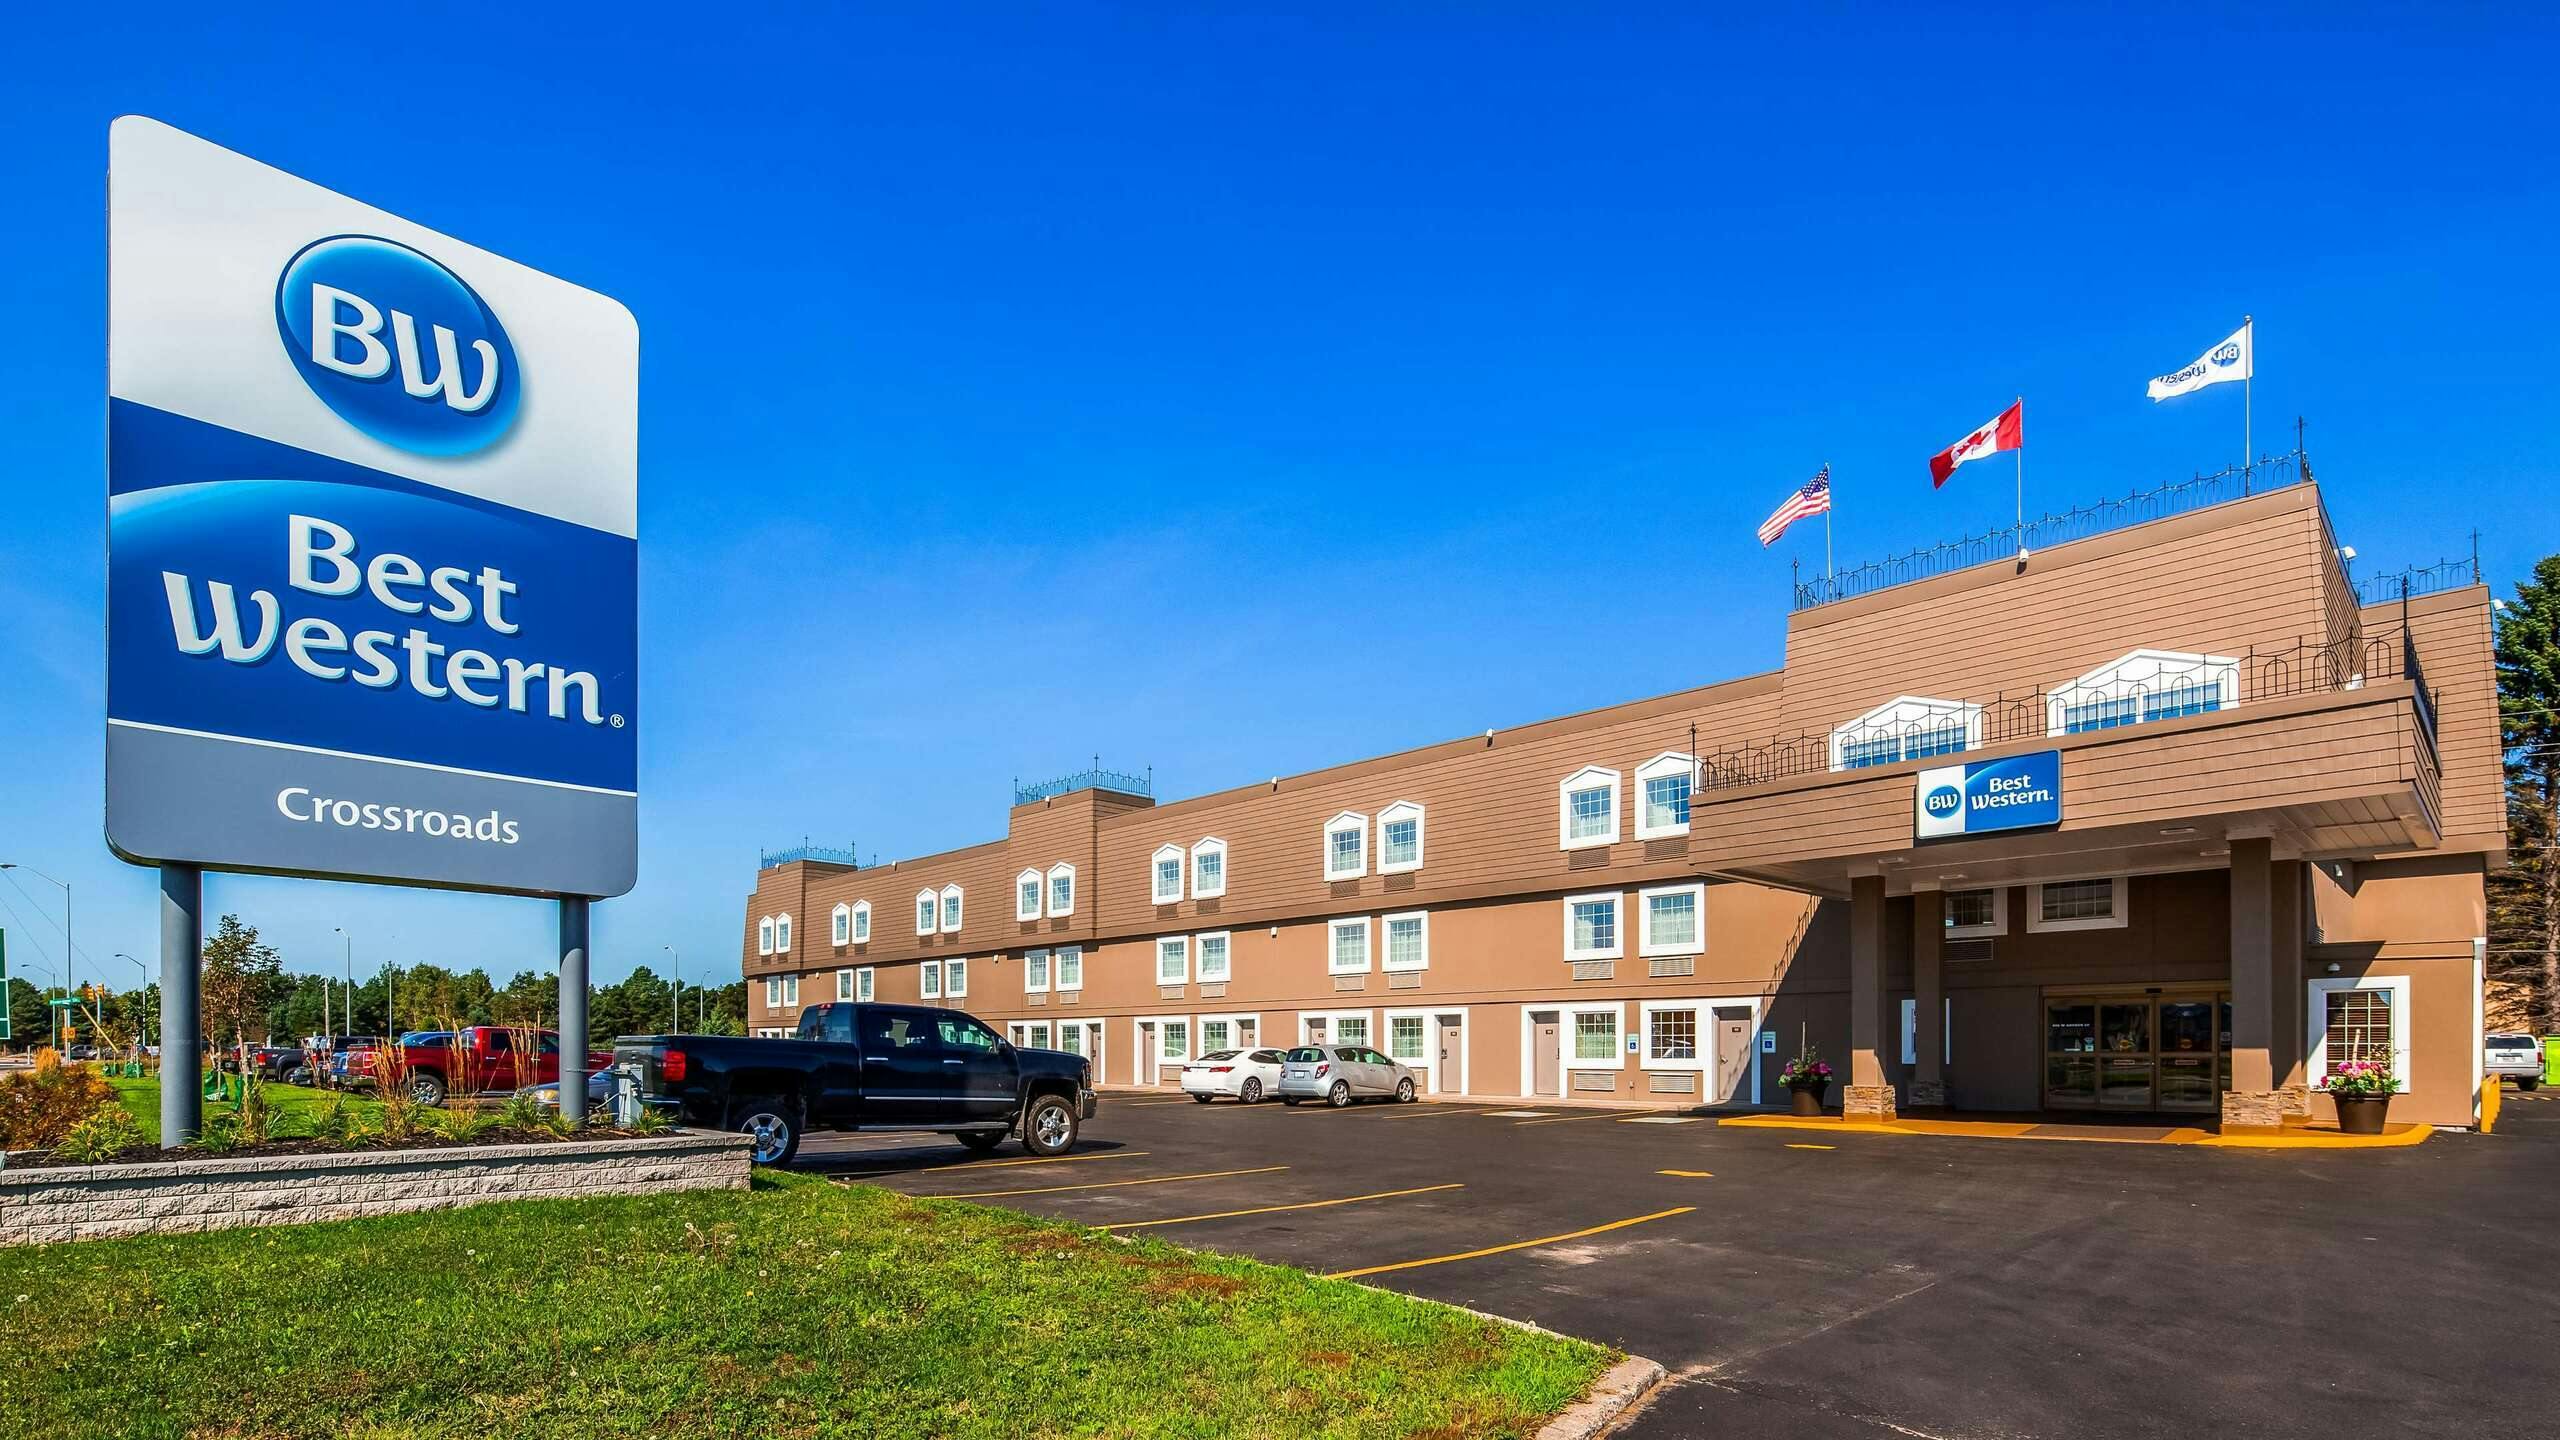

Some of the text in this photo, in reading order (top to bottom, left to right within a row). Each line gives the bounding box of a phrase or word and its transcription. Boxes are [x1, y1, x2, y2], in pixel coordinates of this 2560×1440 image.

[311, 282, 499, 413] BW
[288, 513, 520, 635] Best
[1928, 793, 1958, 810] BW
[1989, 774, 2032, 793] Best
[276, 786, 520, 845] Crossroads
